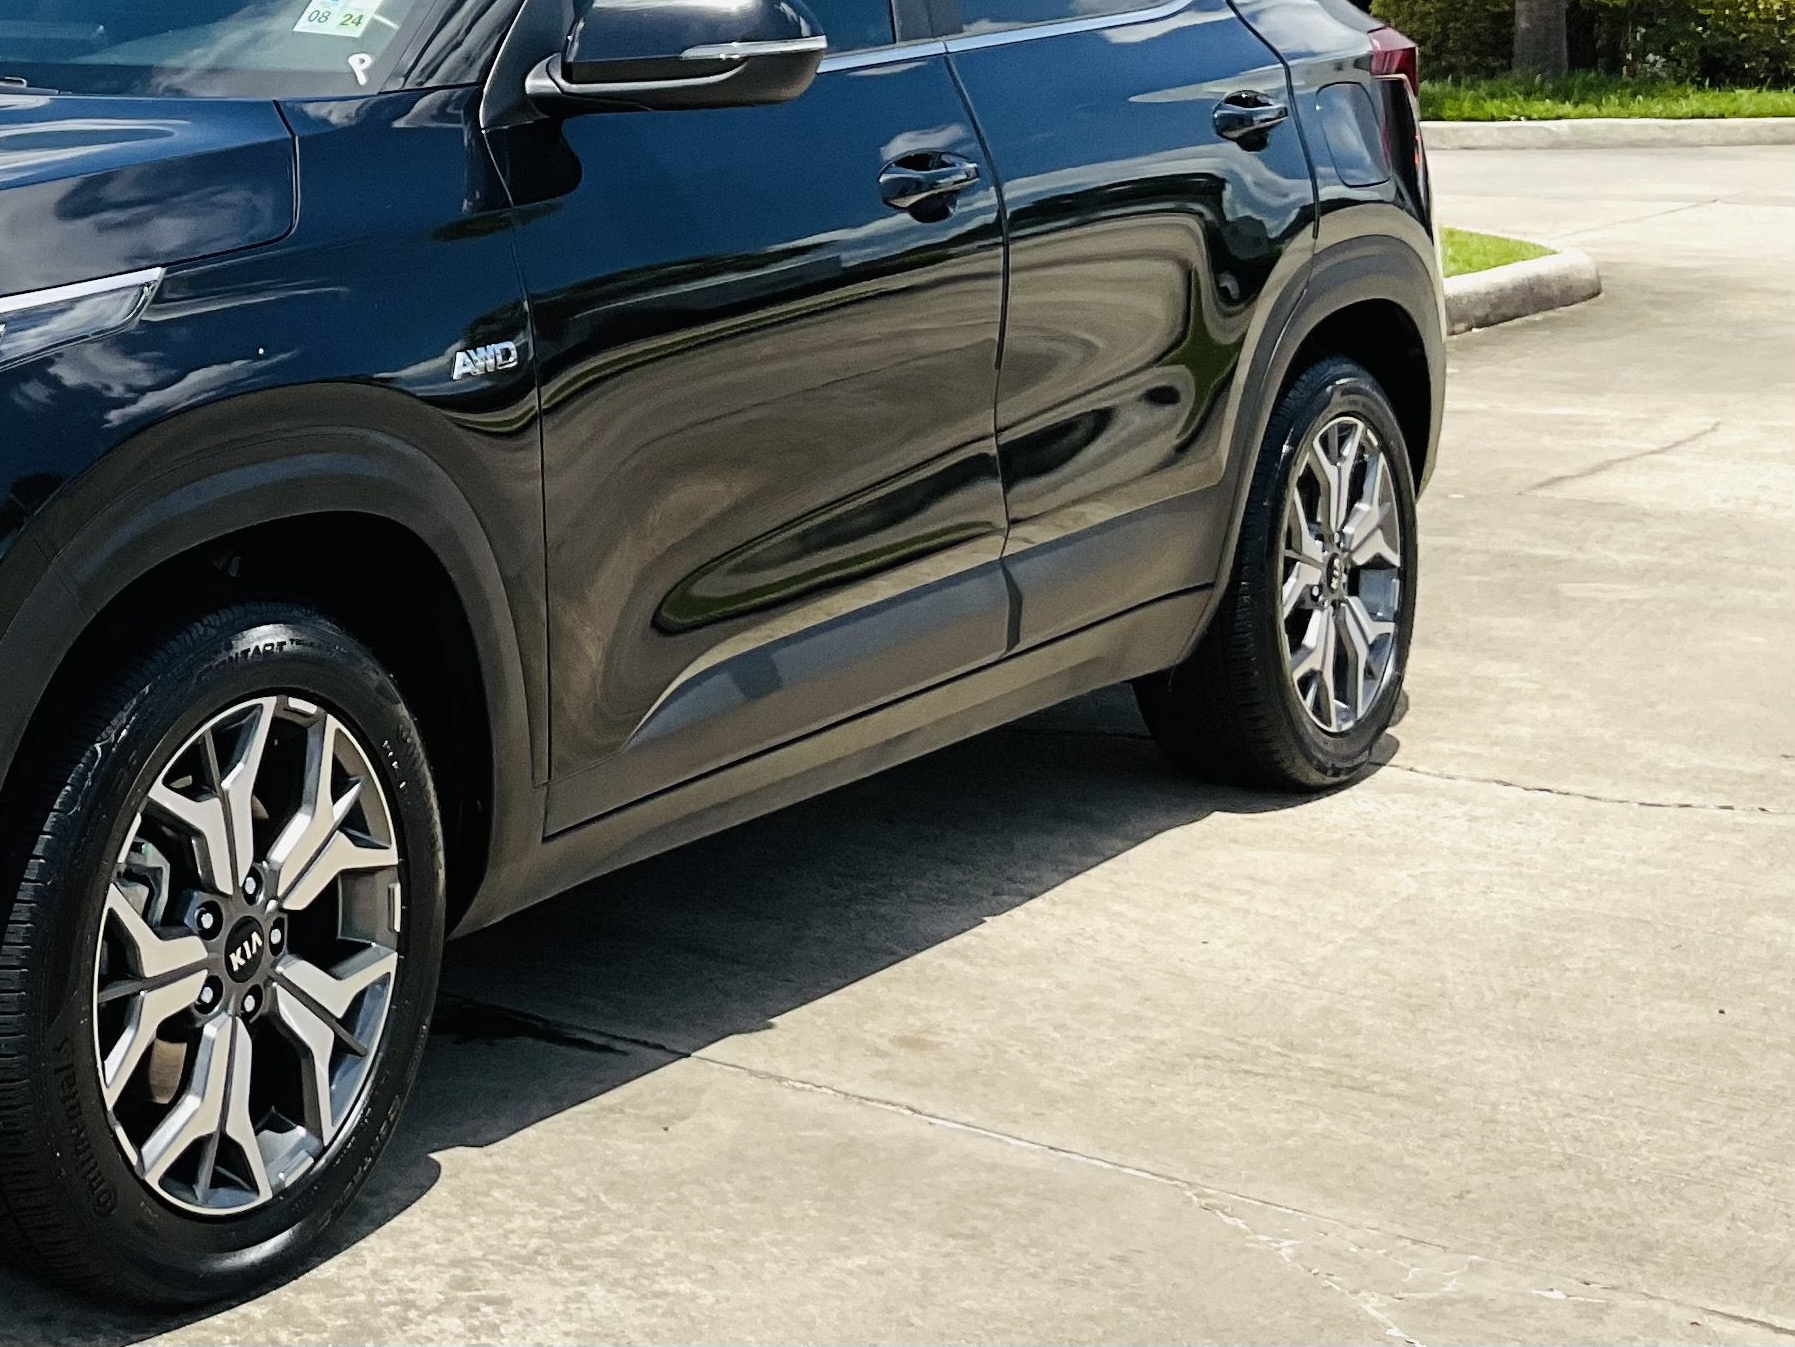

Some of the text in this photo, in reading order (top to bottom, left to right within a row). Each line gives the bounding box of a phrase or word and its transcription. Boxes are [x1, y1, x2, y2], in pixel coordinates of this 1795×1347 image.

[308, 9, 364, 27] 08 24
[452, 341, 518, 381] AWD
[229, 931, 263, 972] KIA
